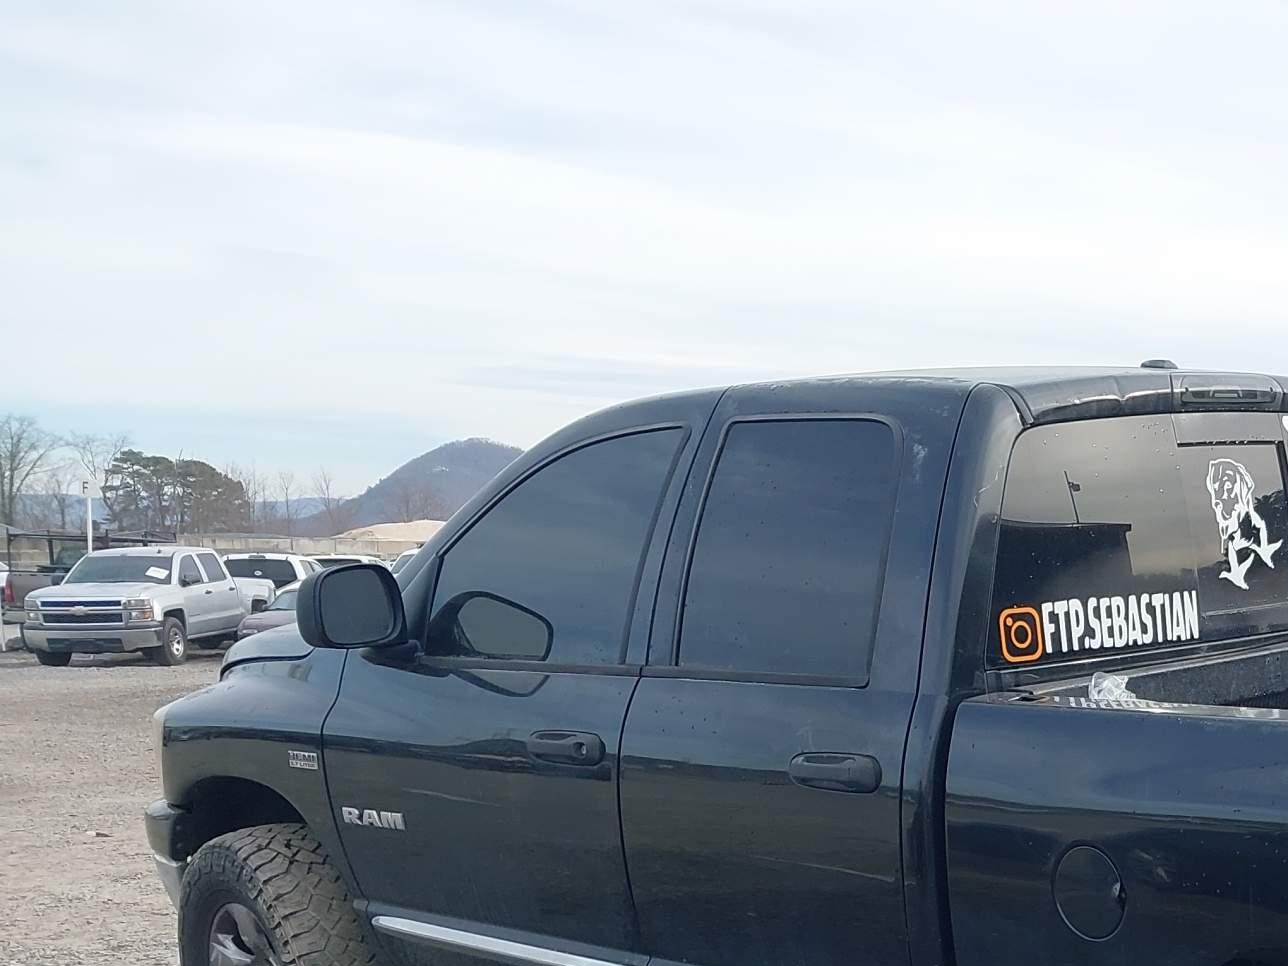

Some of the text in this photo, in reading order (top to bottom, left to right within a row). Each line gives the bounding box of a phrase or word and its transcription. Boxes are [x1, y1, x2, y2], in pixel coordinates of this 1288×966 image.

[82, 481, 89, 494] F
[1041, 590, 1200, 653] FTP.SEBASTIAN
[341, 806, 406, 830] RAM
